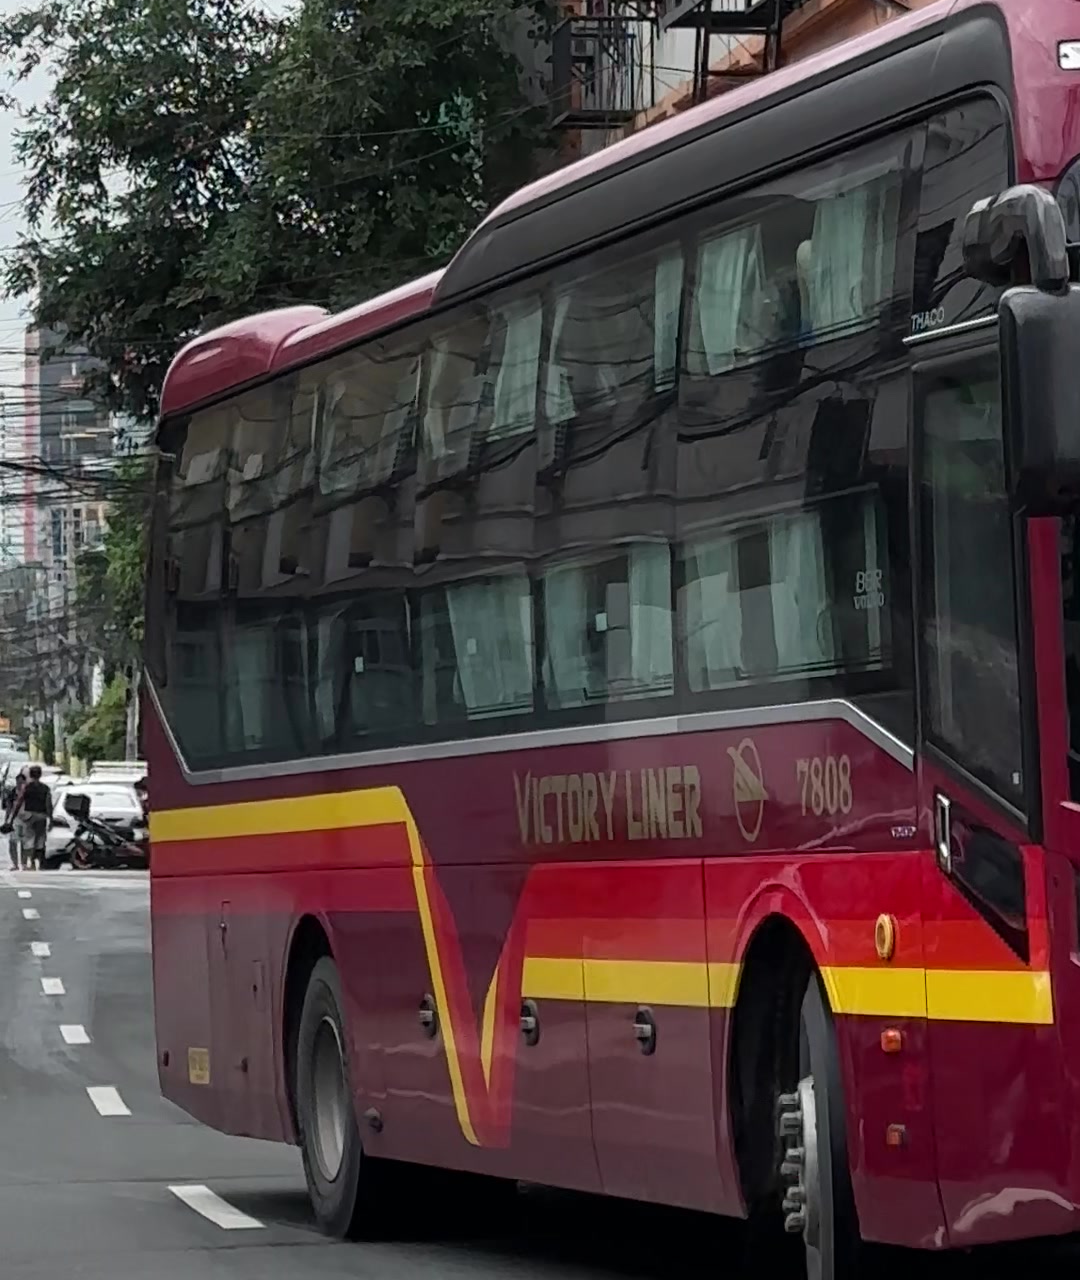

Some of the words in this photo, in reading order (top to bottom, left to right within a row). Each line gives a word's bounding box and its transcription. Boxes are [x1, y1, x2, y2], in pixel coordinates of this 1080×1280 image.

[910, 306, 945, 332] THACO
[512, 769, 618, 845] VICTORY
[625, 765, 703, 841] LINER
[796, 754, 853, 817] 7808
